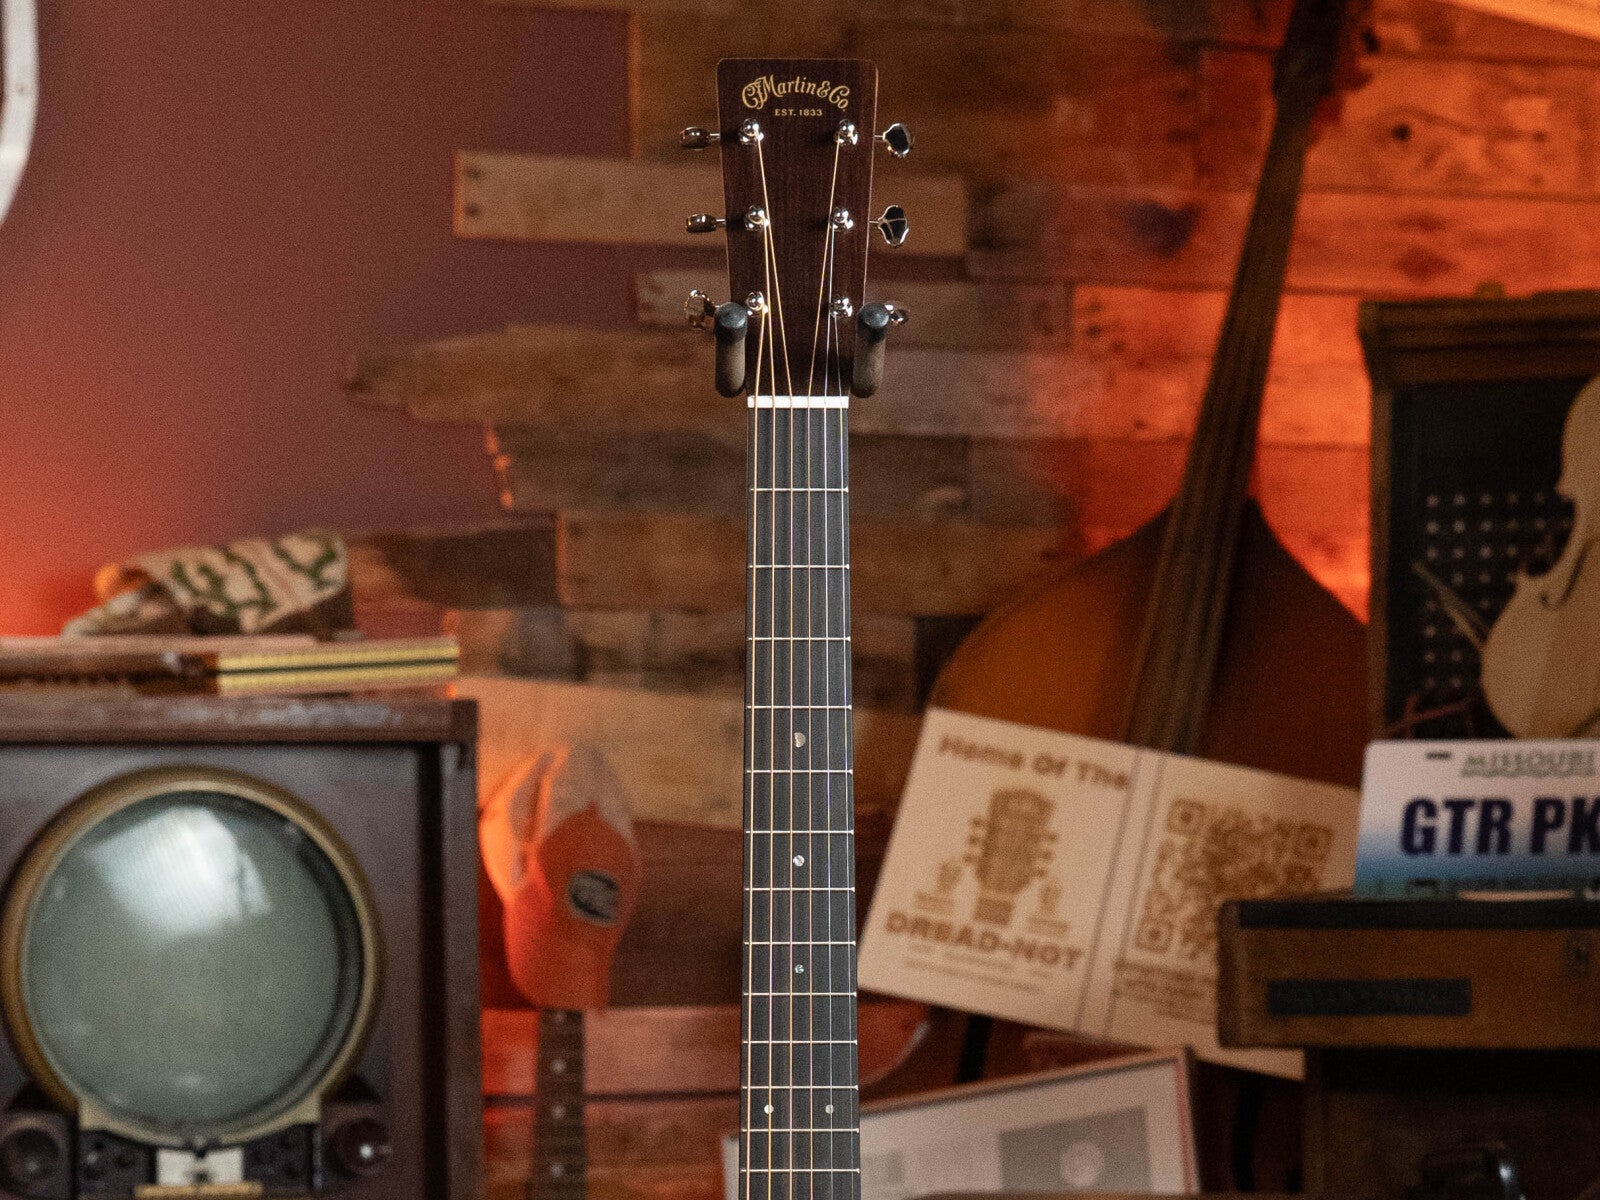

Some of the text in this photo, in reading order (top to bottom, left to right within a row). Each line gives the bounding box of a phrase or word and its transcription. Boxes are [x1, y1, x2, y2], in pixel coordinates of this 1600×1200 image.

[774, 108, 823, 116] EST. 1833
[1460, 750, 1596, 778] MISSOURI
[1401, 796, 1513, 857] GTR
[884, 909, 1084, 970] DREAD-NOT
